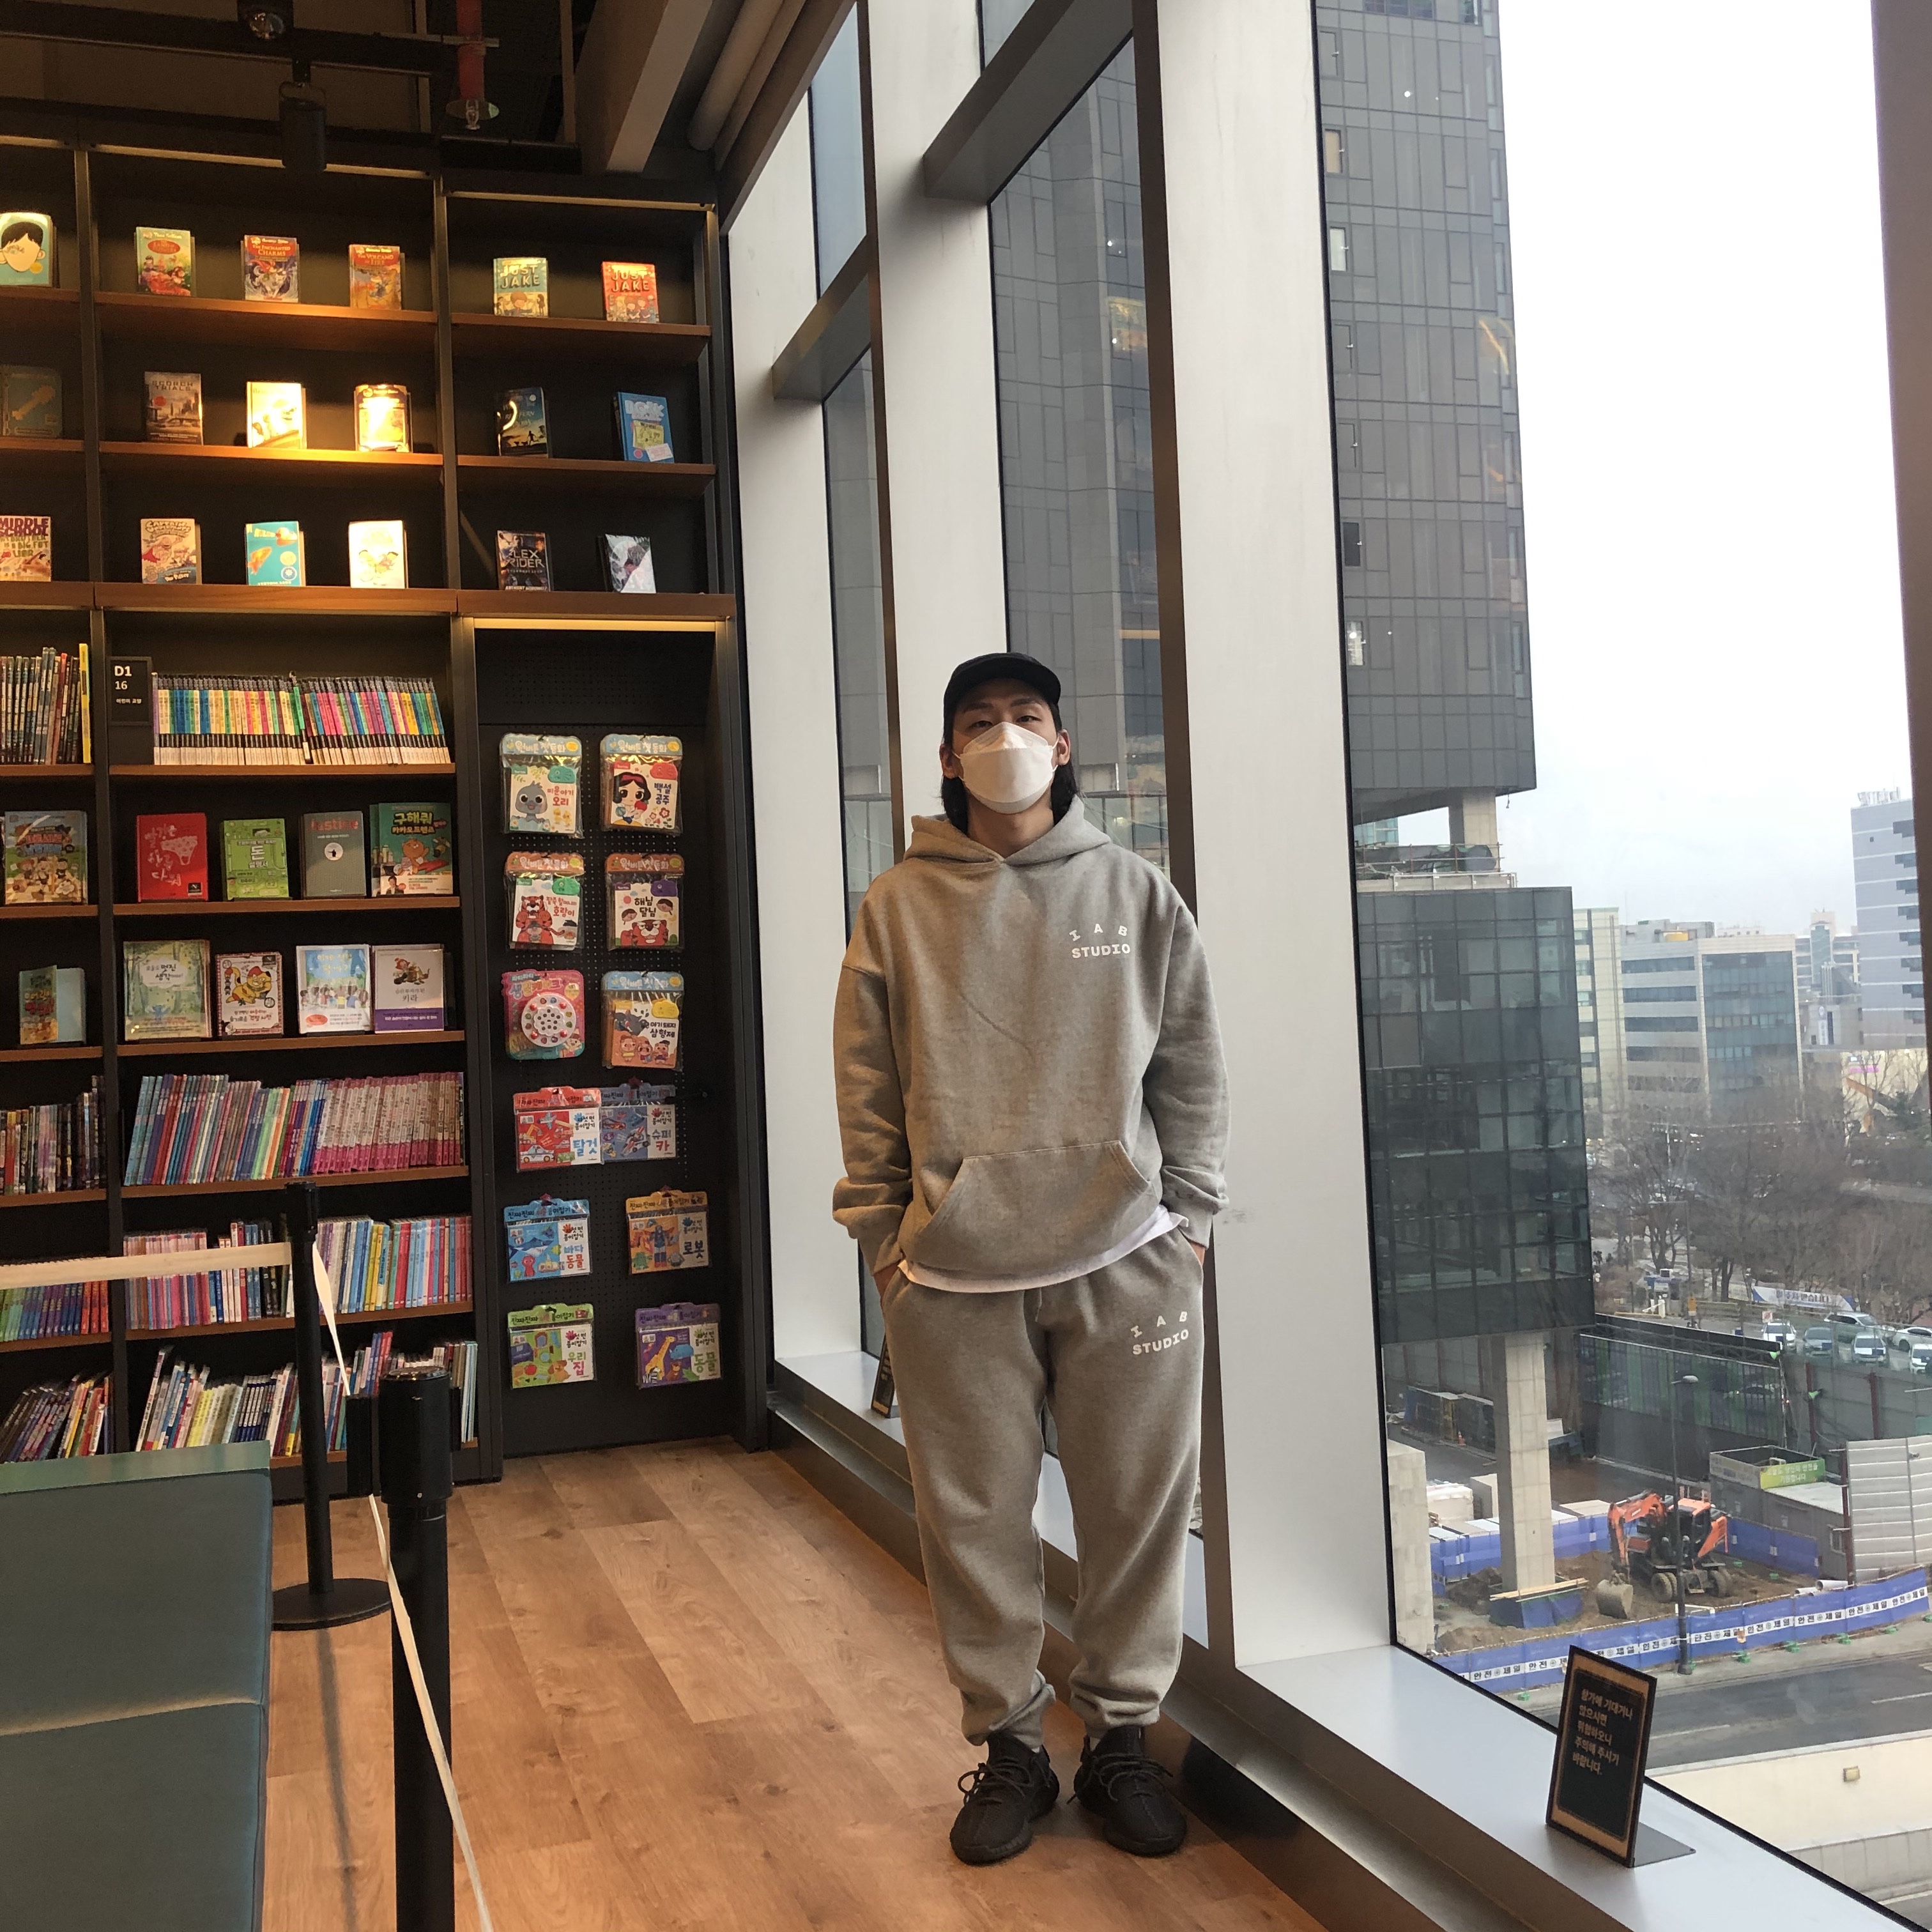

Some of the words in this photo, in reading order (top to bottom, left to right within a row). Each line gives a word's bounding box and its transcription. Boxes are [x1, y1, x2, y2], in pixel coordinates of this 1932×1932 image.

[500, 264, 537, 277] JUST
[501, 275, 540, 289] JAKE
[611, 280, 650, 293] JAKE
[0, 518, 49, 528] MIDDLE
[505, 558, 545, 569] RIDER
[114, 665, 132, 677] D1
[114, 680, 128, 690] 16
[654, 783, 671, 795] 백설
[553, 797, 569, 806] 오리
[656, 794, 670, 806] 공주
[392, 826, 435, 834] 카카오프렌즈
[251, 845, 265, 860] 돈
[634, 896, 654, 906] 해님
[553, 906, 574, 917] 호랑이
[640, 907, 657, 917] 달님
[1071, 943, 1131, 959] STUDIO
[402, 994, 418, 1002] 키라
[650, 1029, 675, 1039] 삼형제
[652, 1129, 671, 1140] 슈퍼
[572, 1137, 597, 1157] 탈것
[656, 1140, 670, 1151] 카
[564, 1244, 583, 1254] 바다
[683, 1240, 705, 1259] 로봇
[566, 1254, 584, 1269] 동물
[1132, 1329, 1189, 1355] STUDIO
[568, 1351, 586, 1362] 우리
[694, 1351, 717, 1373] 동물
[572, 1361, 585, 1376] 집
[1892, 1595, 1905, 1606] 안전
[1912, 1588, 1925, 1598] 제일
[1848, 1606, 1864, 1616] 안전
[1873, 1600, 1887, 1610] 제일
[1797, 1615, 1815, 1625] 안전
[1825, 1611, 1842, 1620] 제일
[1747, 1624, 1764, 1634] 안전
[1774, 1618, 1790, 1628] 제일
[1616, 1646, 1635, 1655] 제일
[1643, 1641, 1660, 1652] 안전
[1529, 1660, 1547, 1671] 안전
[1473, 1669, 1492, 1681] 안전
[1503, 1664, 1521, 1675] 제일
[1604, 1695, 1633, 1721] 기대거나
[1579, 1705, 1608, 1726] 앉으시면
[1574, 1736, 1596, 1756] 주의해
[1597, 1744, 1620, 1767] 주시기
